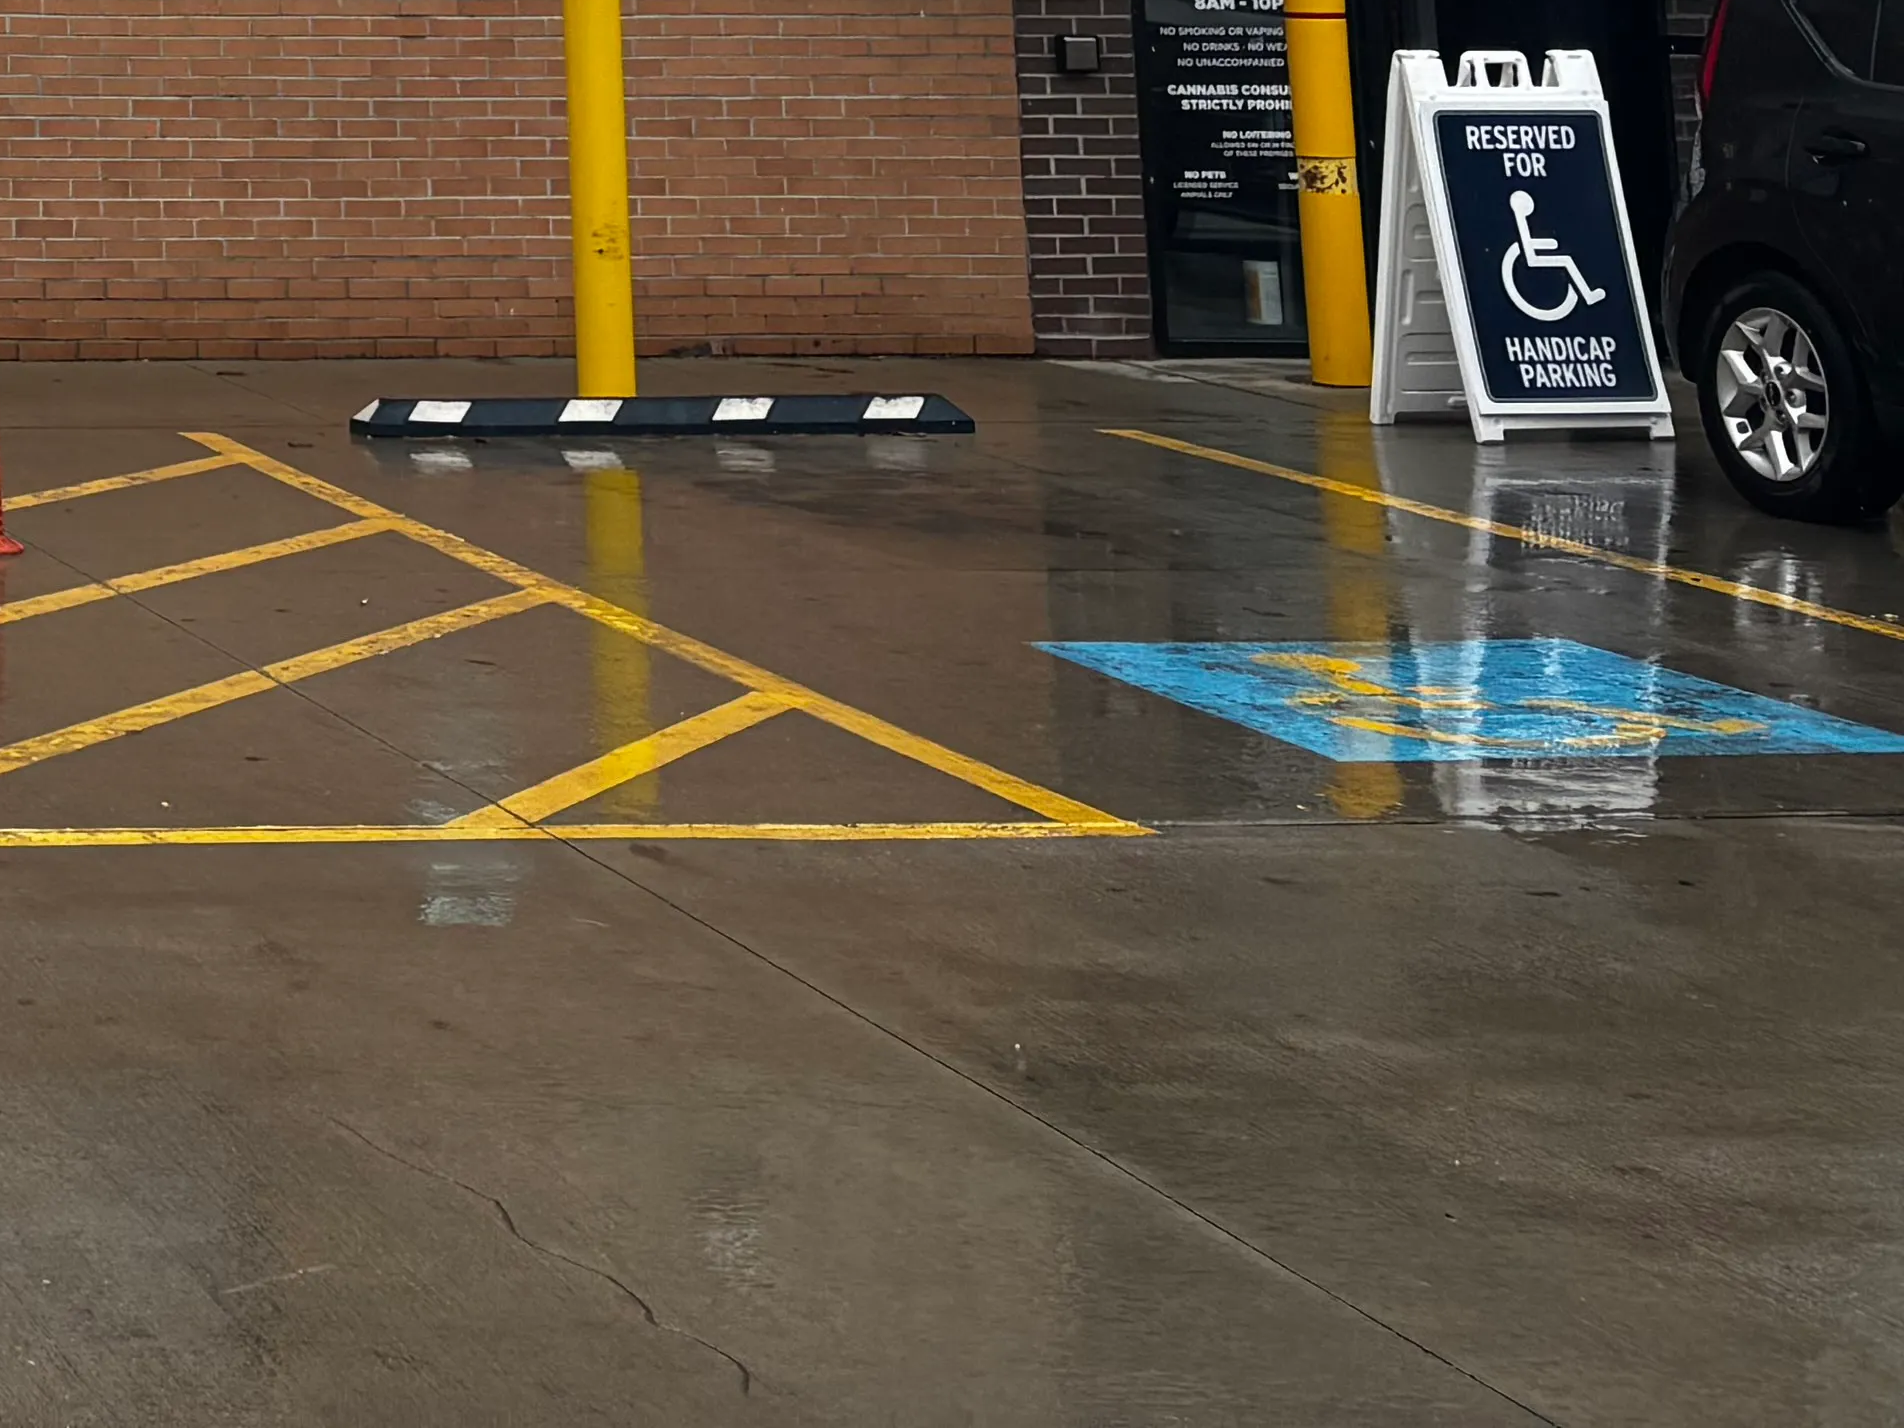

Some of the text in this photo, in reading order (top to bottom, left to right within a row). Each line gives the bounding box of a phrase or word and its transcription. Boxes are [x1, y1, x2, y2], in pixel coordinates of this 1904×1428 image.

[1159, 27, 1284, 36] NO SMOKING OR VAPING
[1183, 42, 1199, 51] NO
[1201, 42, 1240, 51] DRINKS
[1247, 42, 1264, 51] NO
[1177, 58, 1193, 67] NO
[1167, 84, 1239, 96] CANNABIS
[1181, 99, 1244, 111] STRICTLY
[1464, 125, 1577, 150] RESERVED
[1503, 152, 1548, 178] FOR
[1505, 336, 1617, 362] HANDICAP
[1520, 362, 1617, 389] PARKING
